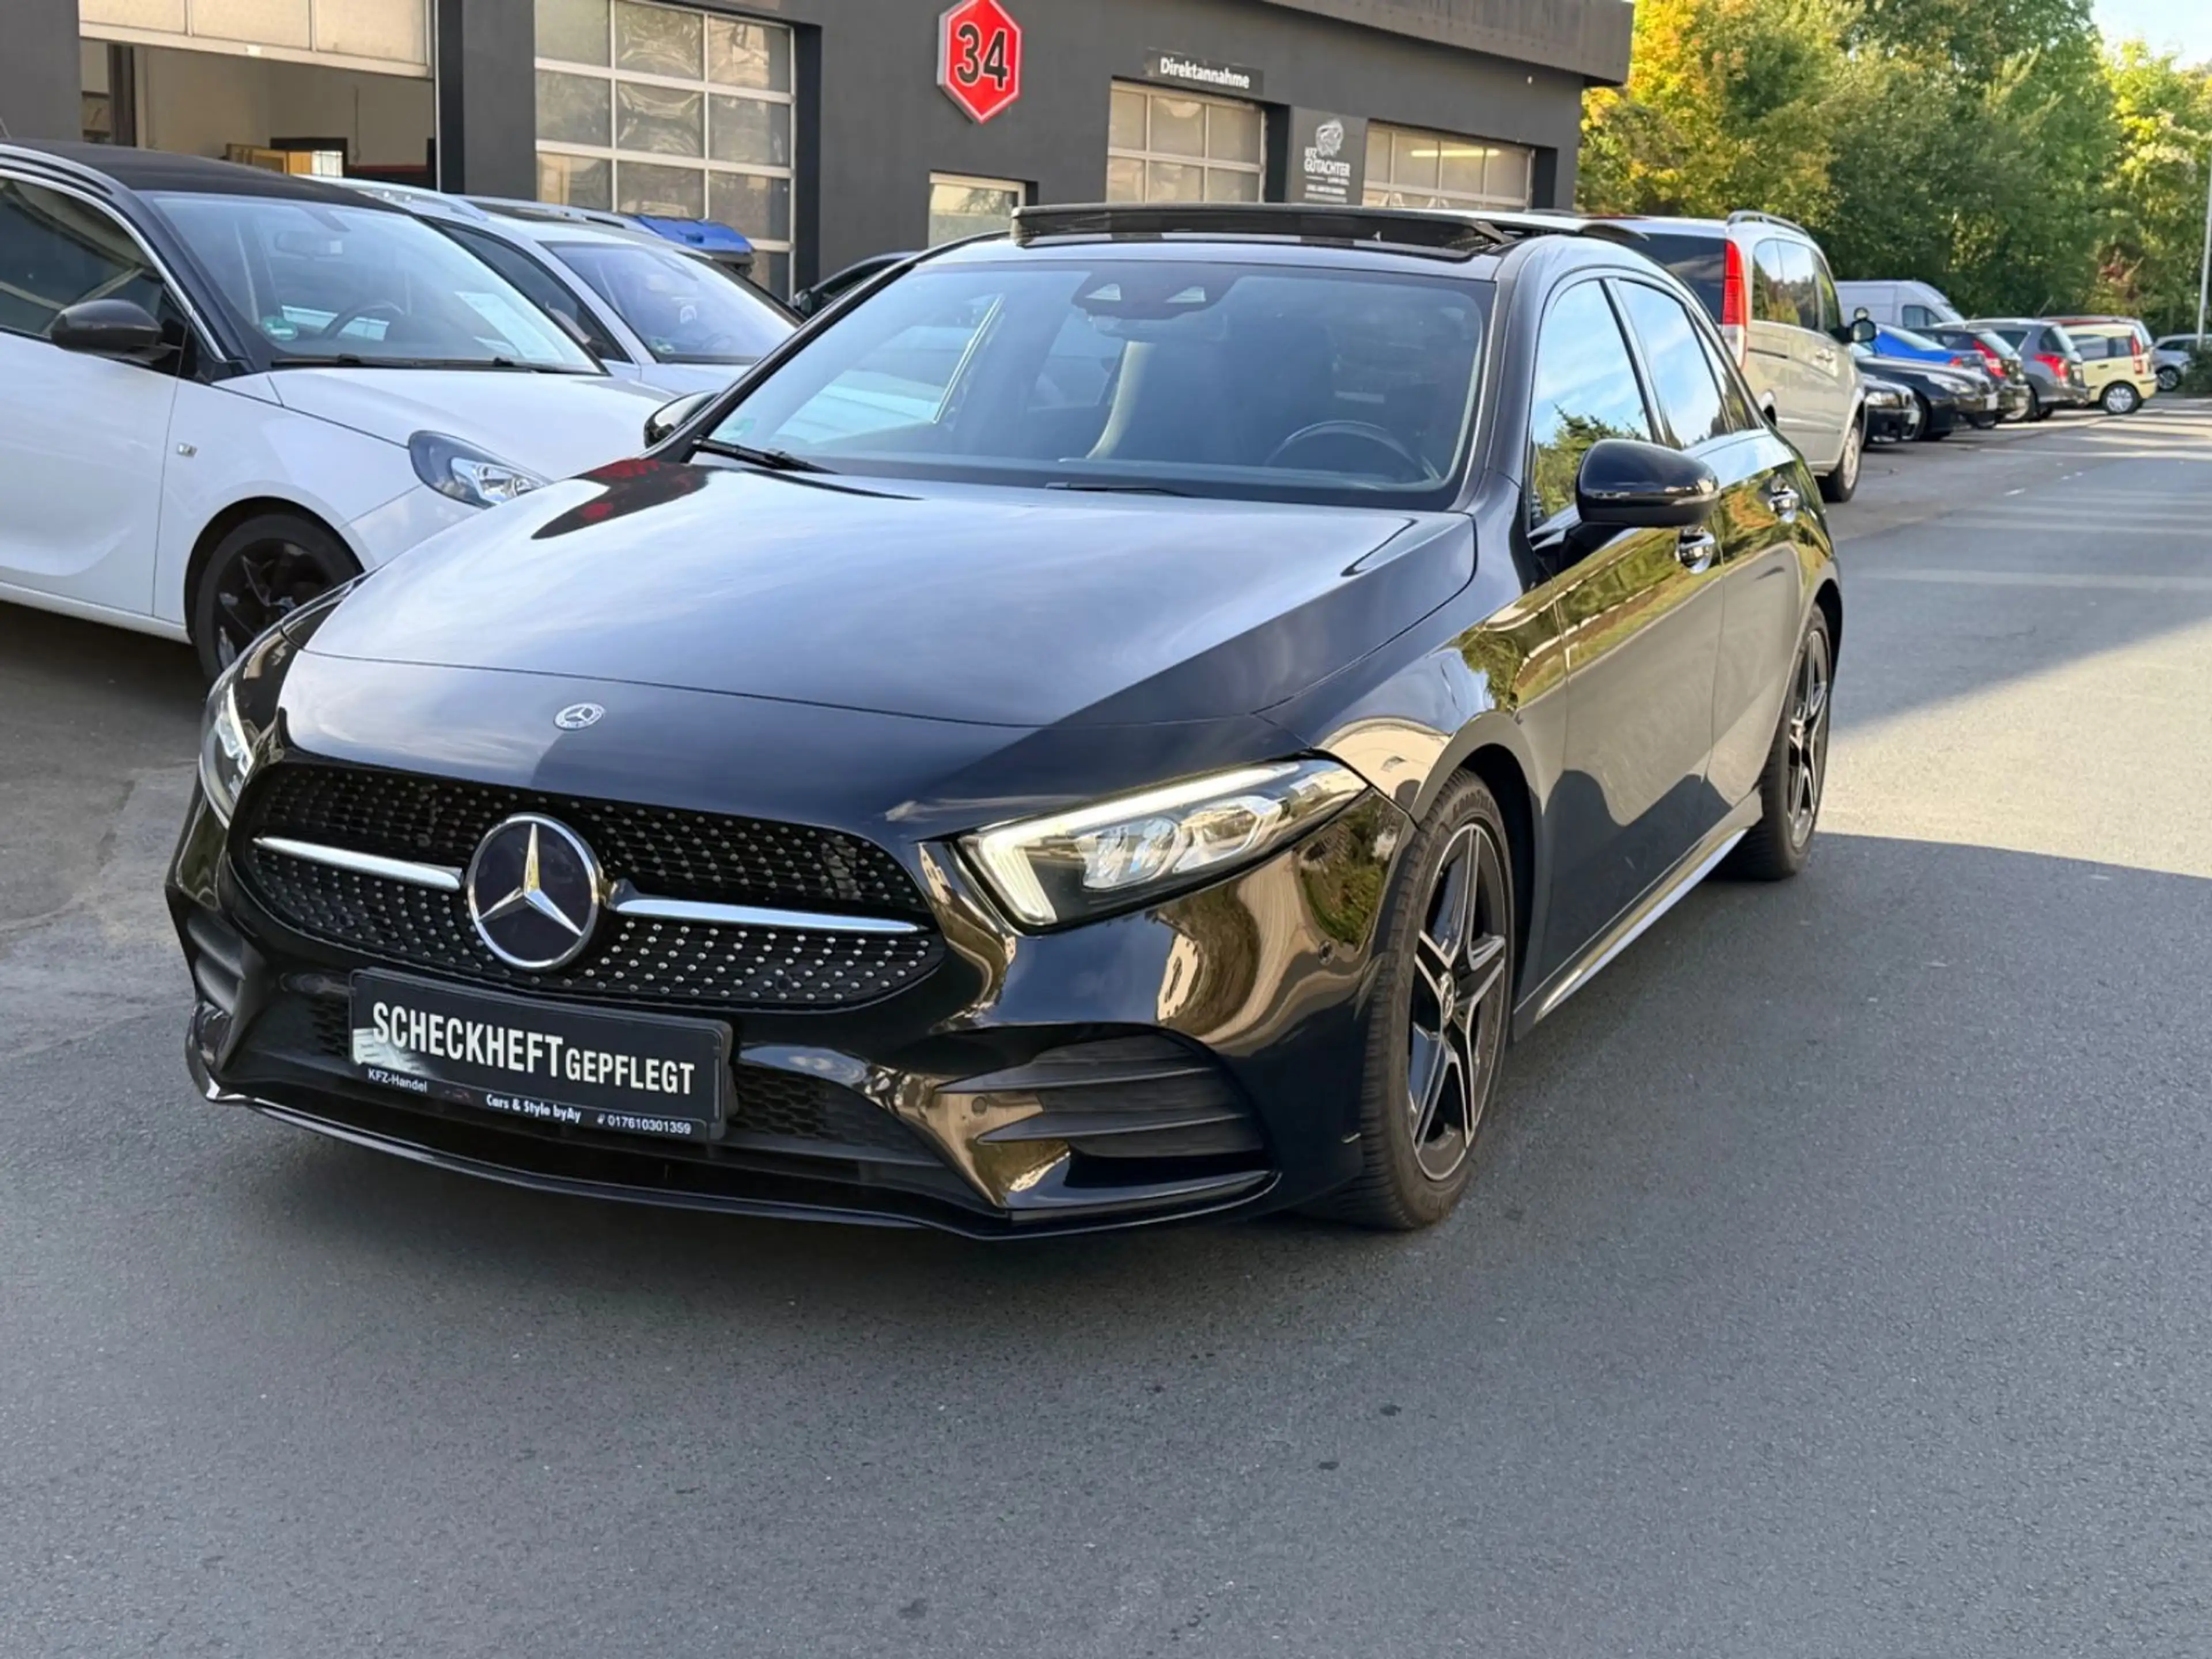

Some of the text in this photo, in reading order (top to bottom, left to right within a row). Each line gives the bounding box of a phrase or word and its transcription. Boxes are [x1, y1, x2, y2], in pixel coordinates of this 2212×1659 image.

[956, 22, 1009, 90] 34
[1160, 56, 1250, 89] Direktannahme
[1304, 158, 1350, 177] GUTACHTER
[373, 1002, 695, 1095] SCHECKHEFT GEPFLEGT
[368, 1068, 427, 1093] KFZ-Handel
[486, 1093, 509, 1109] Cars
[512, 1098, 521, 1111] &
[523, 1100, 551, 1118] Style
[607, 1114, 692, 1135] 017610301359
